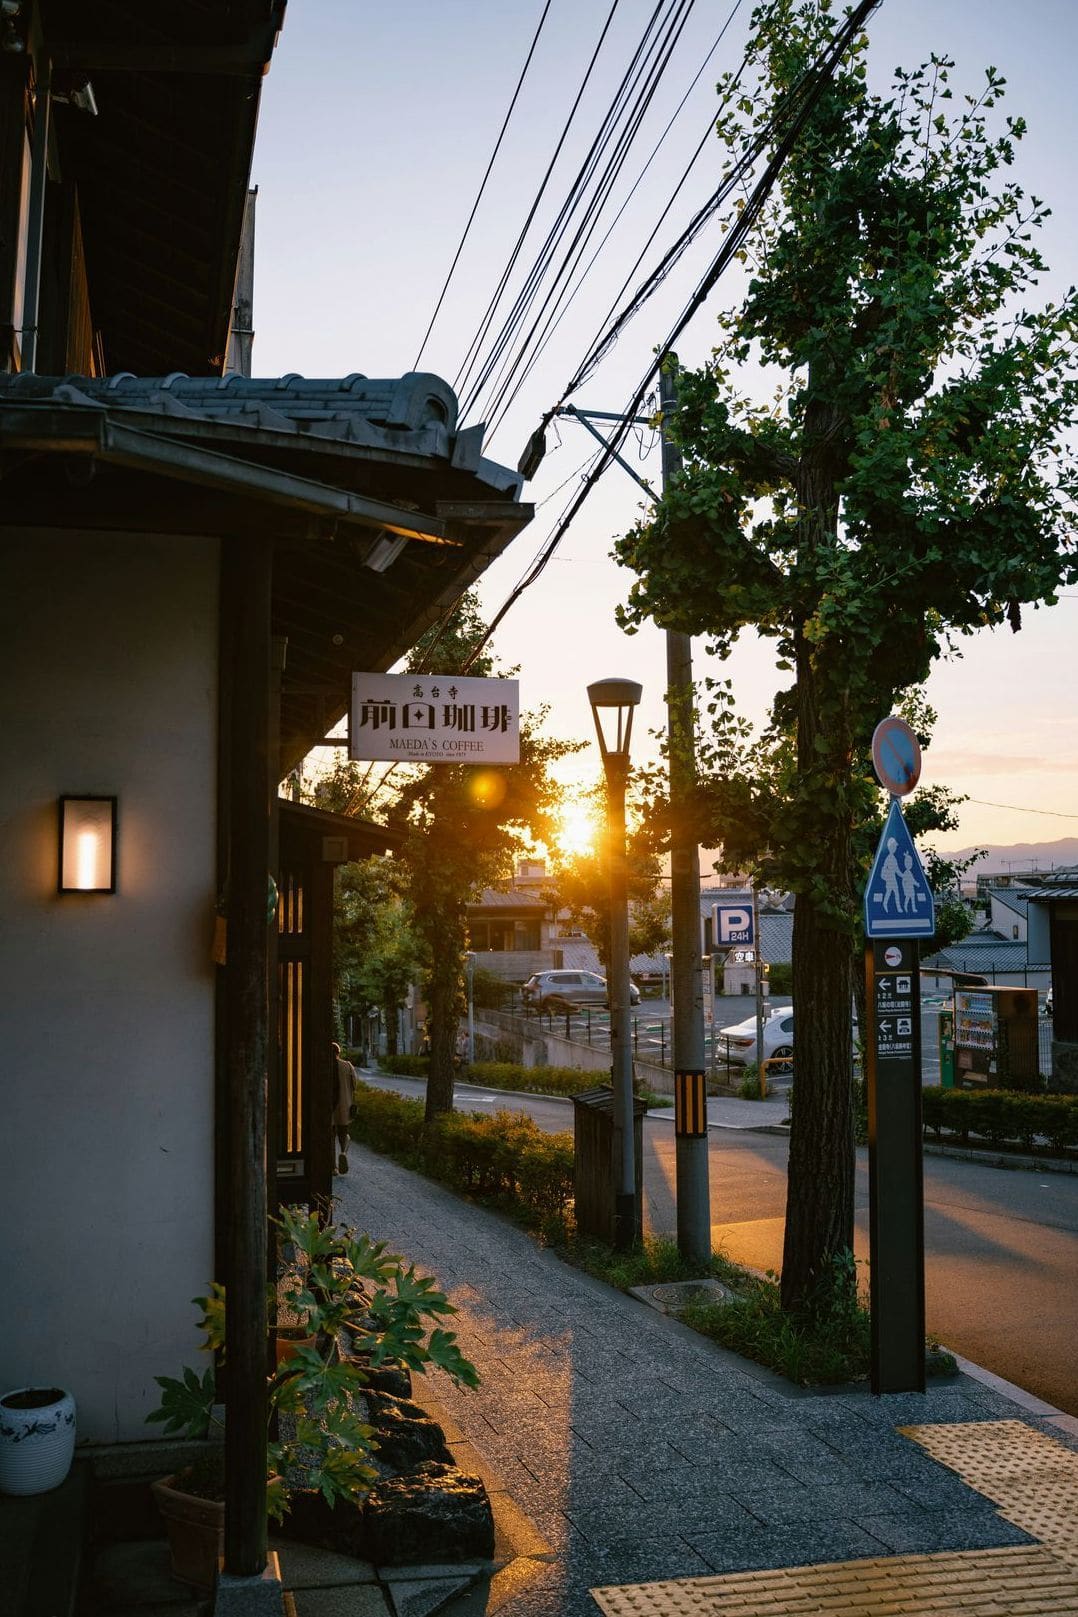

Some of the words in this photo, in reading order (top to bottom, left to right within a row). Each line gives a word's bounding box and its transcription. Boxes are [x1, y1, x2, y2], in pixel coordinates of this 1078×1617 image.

[412, 684, 459, 700] 高台寺
[359, 699, 512, 733] 前田珈琲
[389, 738, 438, 750] MAEDA'S
[442, 741, 485, 752] COFFEE
[720, 909, 750, 942] P
[730, 931, 749, 941] 24H
